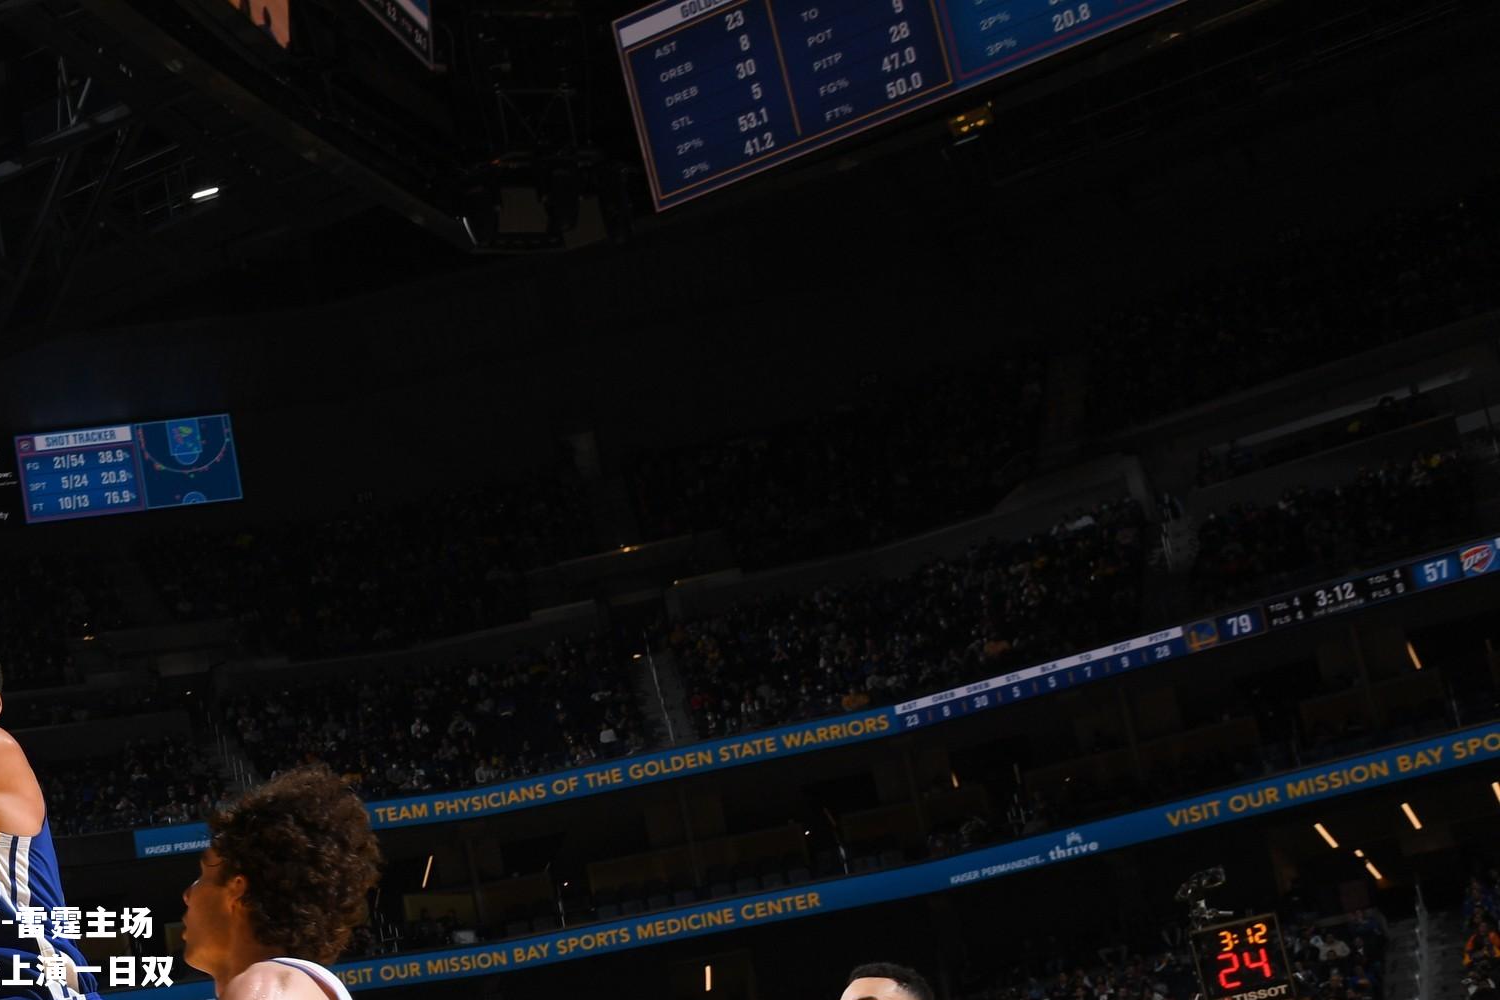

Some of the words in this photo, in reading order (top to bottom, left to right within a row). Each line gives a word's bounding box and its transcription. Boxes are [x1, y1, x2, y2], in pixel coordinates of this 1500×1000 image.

[801, 8, 819, 23] TO
[1052, 5, 1092, 34] 20.8
[654, 41, 677, 60] AST
[725, 10, 745, 32] 23
[807, 29, 833, 47] POT
[813, 52, 843, 73] PITP
[889, 22, 910, 44] 28
[660, 62, 693, 83] OREB
[739, 36, 750, 52] 8
[881, 46, 917, 73] 47.0
[665, 86, 699, 108] DREB
[736, 58, 756, 80] 30
[885, 72, 922, 100] 50.0
[671, 115, 694, 131] STL
[751, 83, 763, 100] 5
[738, 108, 769, 133] 53.1
[743, 132, 775, 157] 41.2
[45, 434, 72, 448] SHOT
[73, 429, 117, 446] TRACKER
[26, 461, 40, 471] FG
[53, 453, 86, 470] 21/54
[61, 474, 89, 490] 5/24
[32, 501, 44, 512] FT
[58, 493, 90, 511] 10/13
[1423, 559, 1449, 583] 57
[1314, 582, 1355, 608] 3:12
[1226, 613, 1252, 637] 79
[905, 714, 919, 728] 23
[1012, 686, 1021, 698] 5
[1049, 676, 1057, 688] 5
[1083, 666, 1092, 678] 7
[375, 803, 429, 823] TEAM
[434, 783, 546, 817] PHYSICIANS
[551, 777, 579, 800] OF
[584, 767, 624, 788] THE
[629, 750, 713, 781] GOLDEN
[719, 738, 777, 761] STATE
[783, 714, 890, 748] WARRIORS
[950, 871, 980, 885] KAISER
[1049, 841, 1100, 862] thrive
[1165, 800, 1222, 828] VISIT
[1228, 787, 1279, 814] OUR
[1286, 760, 1390, 799] MISSION
[1396, 746, 1444, 773] BAY
[380, 959, 422, 982] OUR
[426, 949, 509, 977] MISSION
[513, 942, 550, 964] BAY
[556, 928, 631, 957] SPORTS
[636, 908, 736, 941] MEDICINE
[740, 892, 821, 921] CENTER
[1218, 923, 1267, 951] 3:12
[1217, 948, 1272, 989] 24
